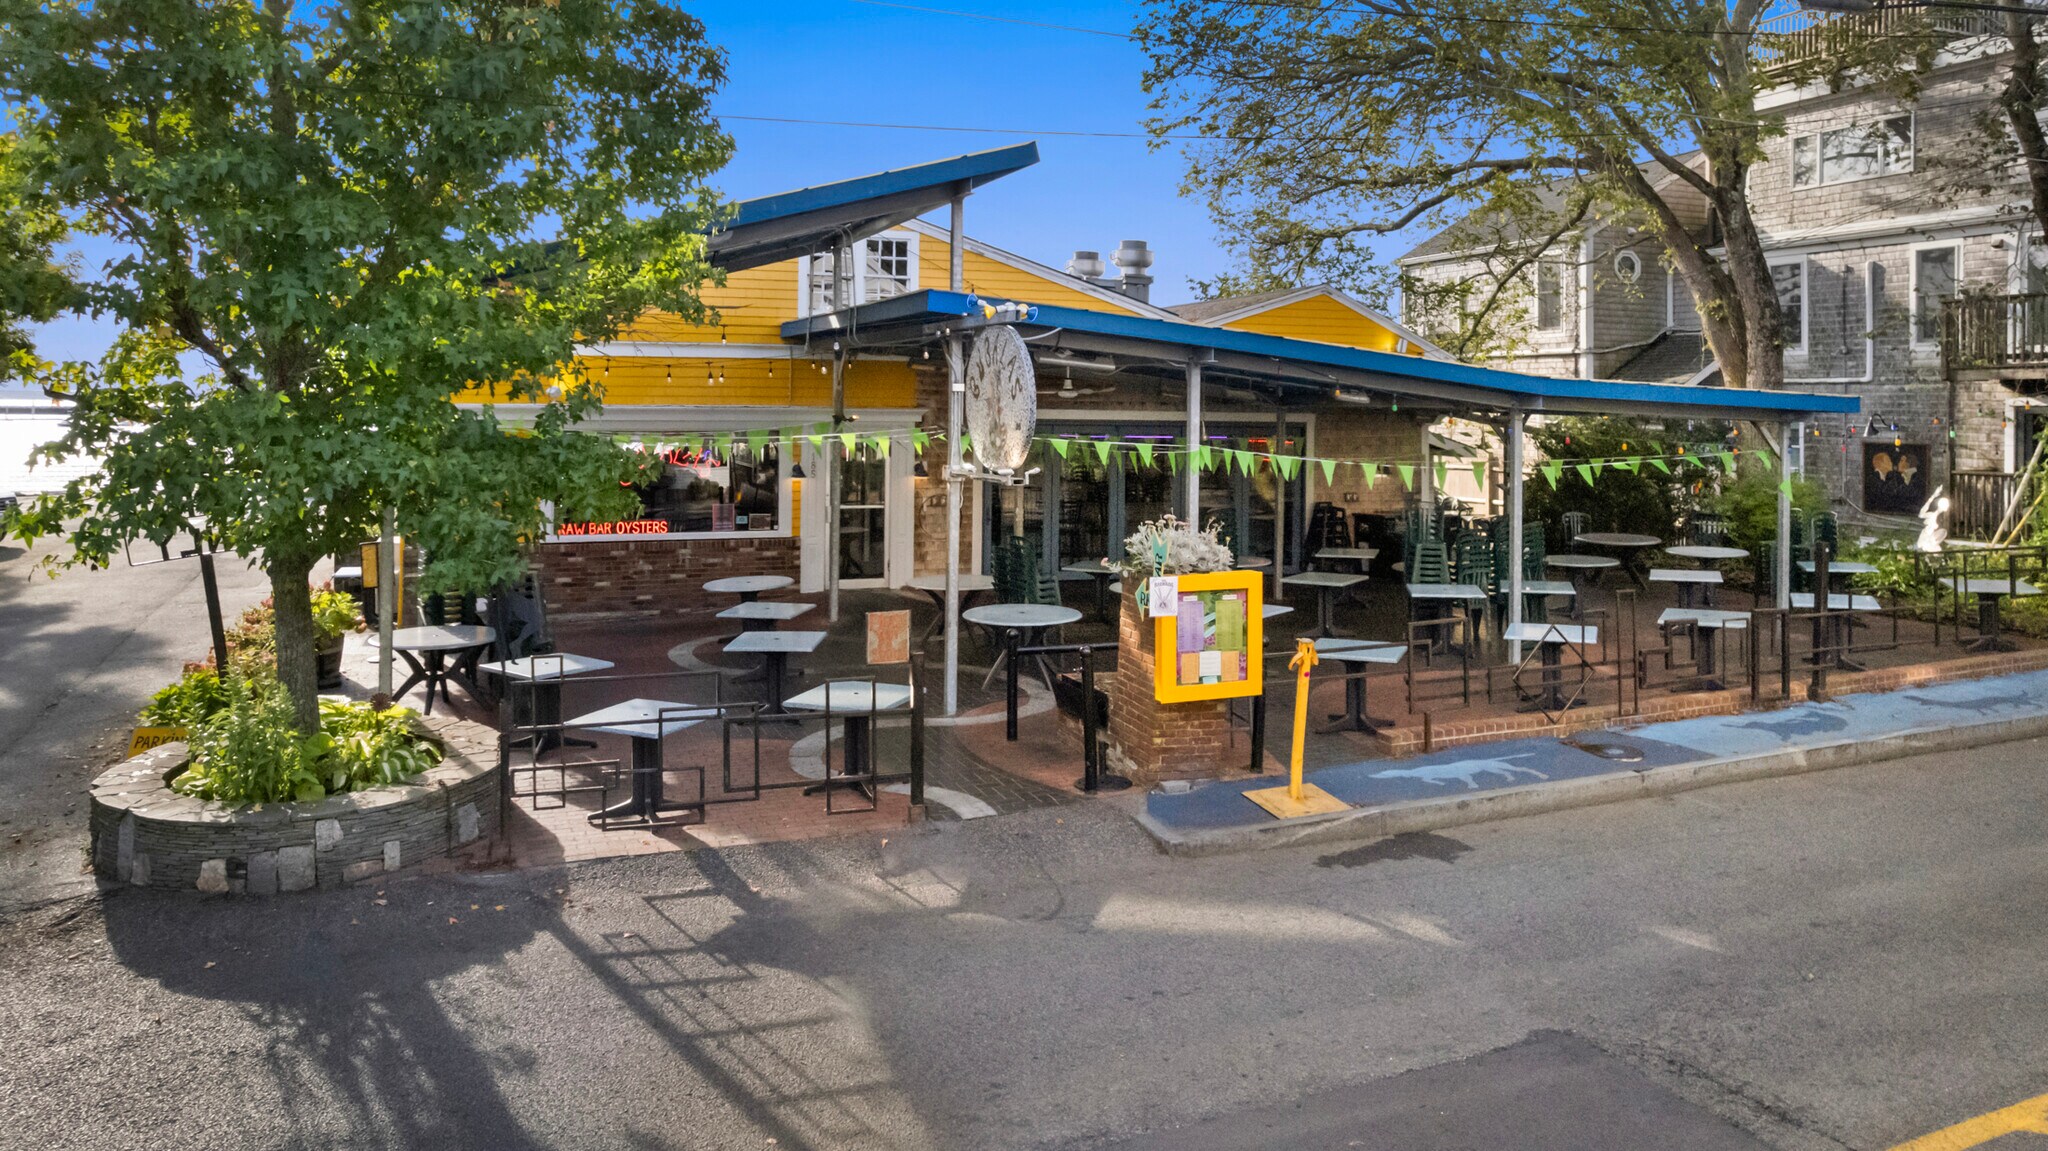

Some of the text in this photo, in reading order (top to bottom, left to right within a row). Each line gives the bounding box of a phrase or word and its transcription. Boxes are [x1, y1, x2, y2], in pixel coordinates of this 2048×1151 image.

[557, 520, 668, 535] RAW BAR OYSTERS
[1154, 552, 1163, 577] AR
